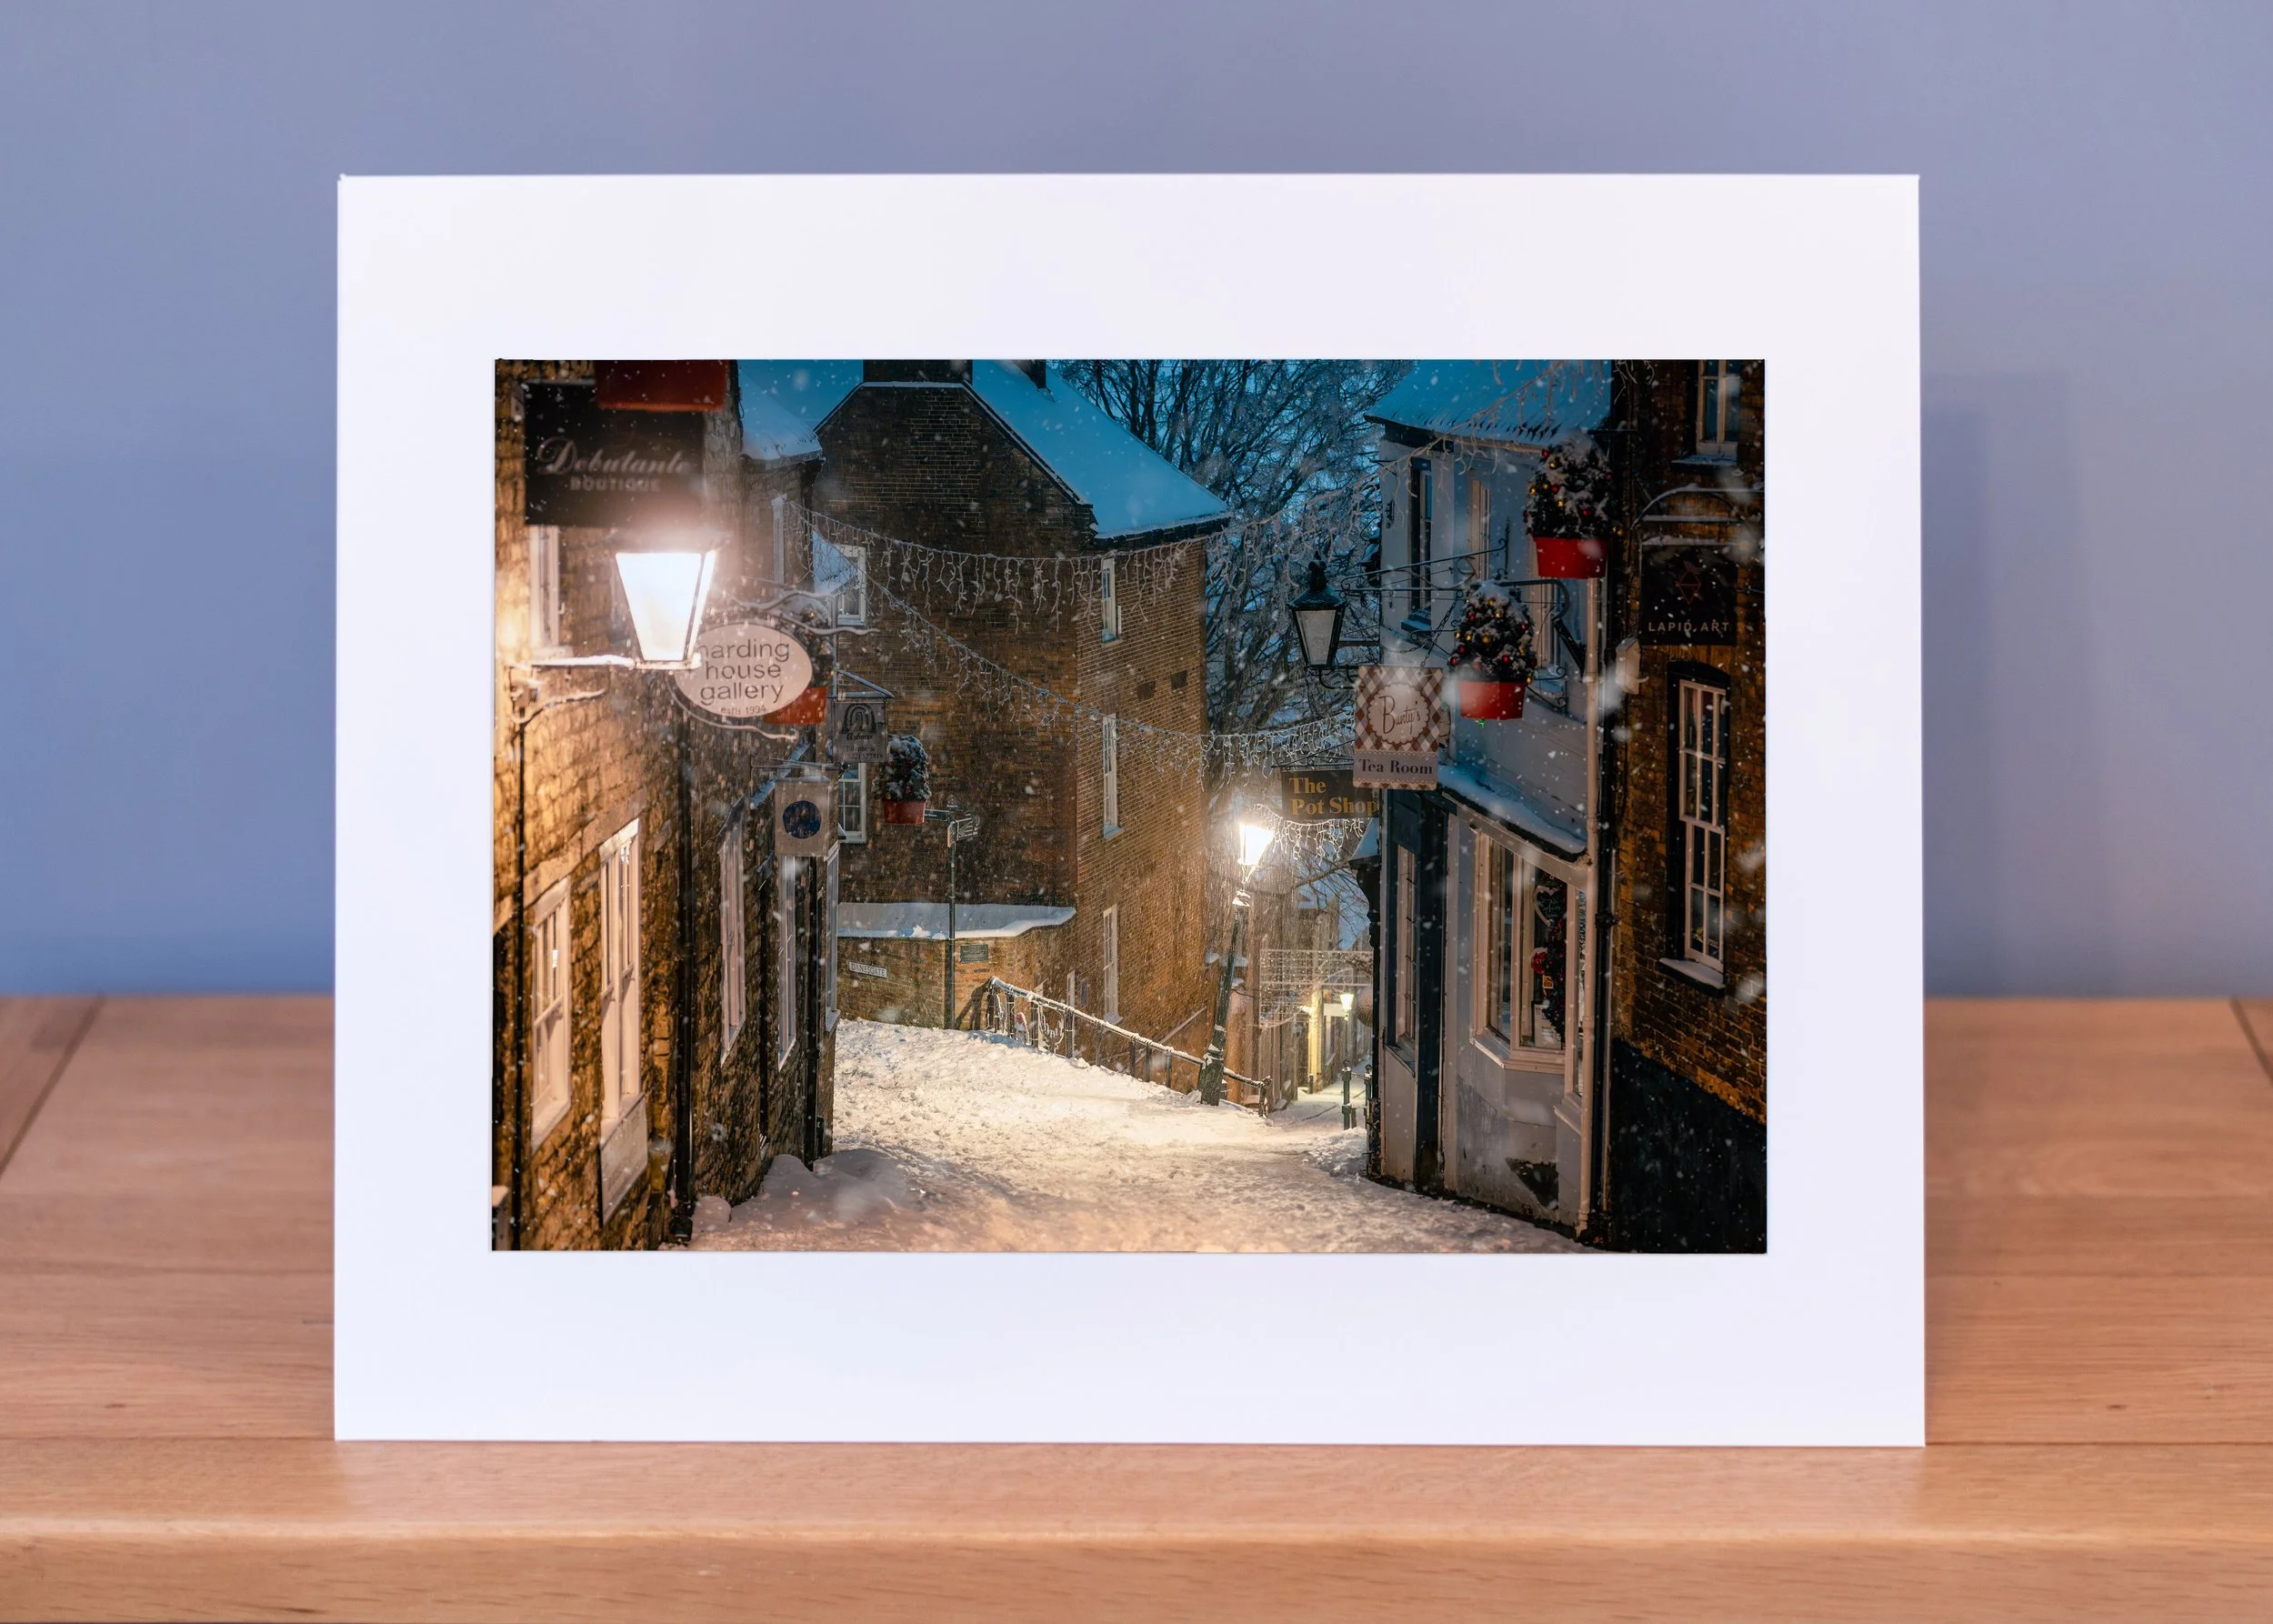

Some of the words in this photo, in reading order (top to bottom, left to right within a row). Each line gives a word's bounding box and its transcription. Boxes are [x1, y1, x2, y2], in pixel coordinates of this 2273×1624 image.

[536, 436, 693, 475] Debutante
[570, 476, 662, 492] BOUTIQUE
[705, 660, 782, 680] house
[699, 682, 784, 707] gallery
[1378, 695, 1421, 735] Bunty's
[1358, 758, 1385, 773] Tea
[1390, 759, 1433, 775] Room
[1288, 777, 1327, 794] The
[1290, 798, 1325, 817] Pot
[1329, 796, 1380, 817] Shop
[851, 962, 886, 977] DANESGATE
